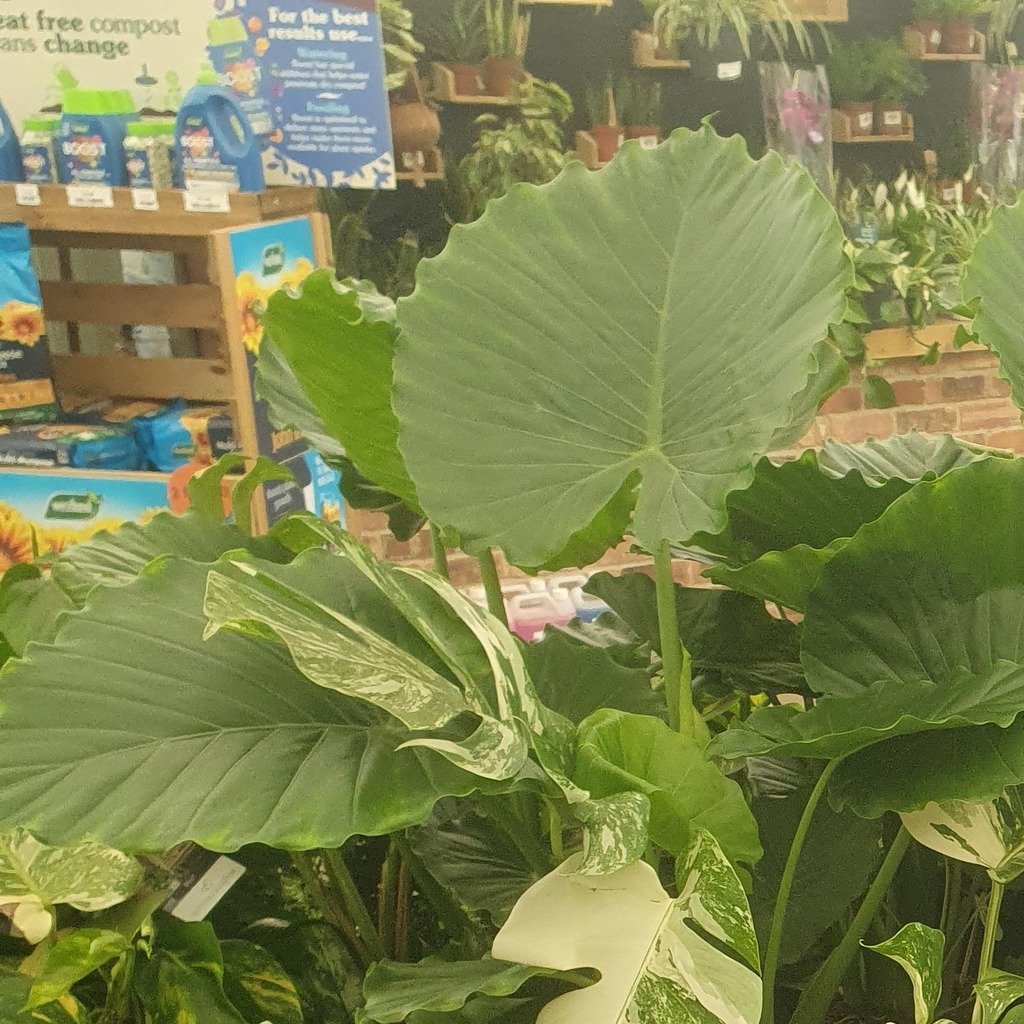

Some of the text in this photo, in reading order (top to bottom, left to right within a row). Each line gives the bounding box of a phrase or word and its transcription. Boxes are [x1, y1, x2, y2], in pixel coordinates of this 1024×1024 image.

[37, 10, 83, 31] free
[90, 16, 181, 38] compost
[44, 33, 130, 60] change
